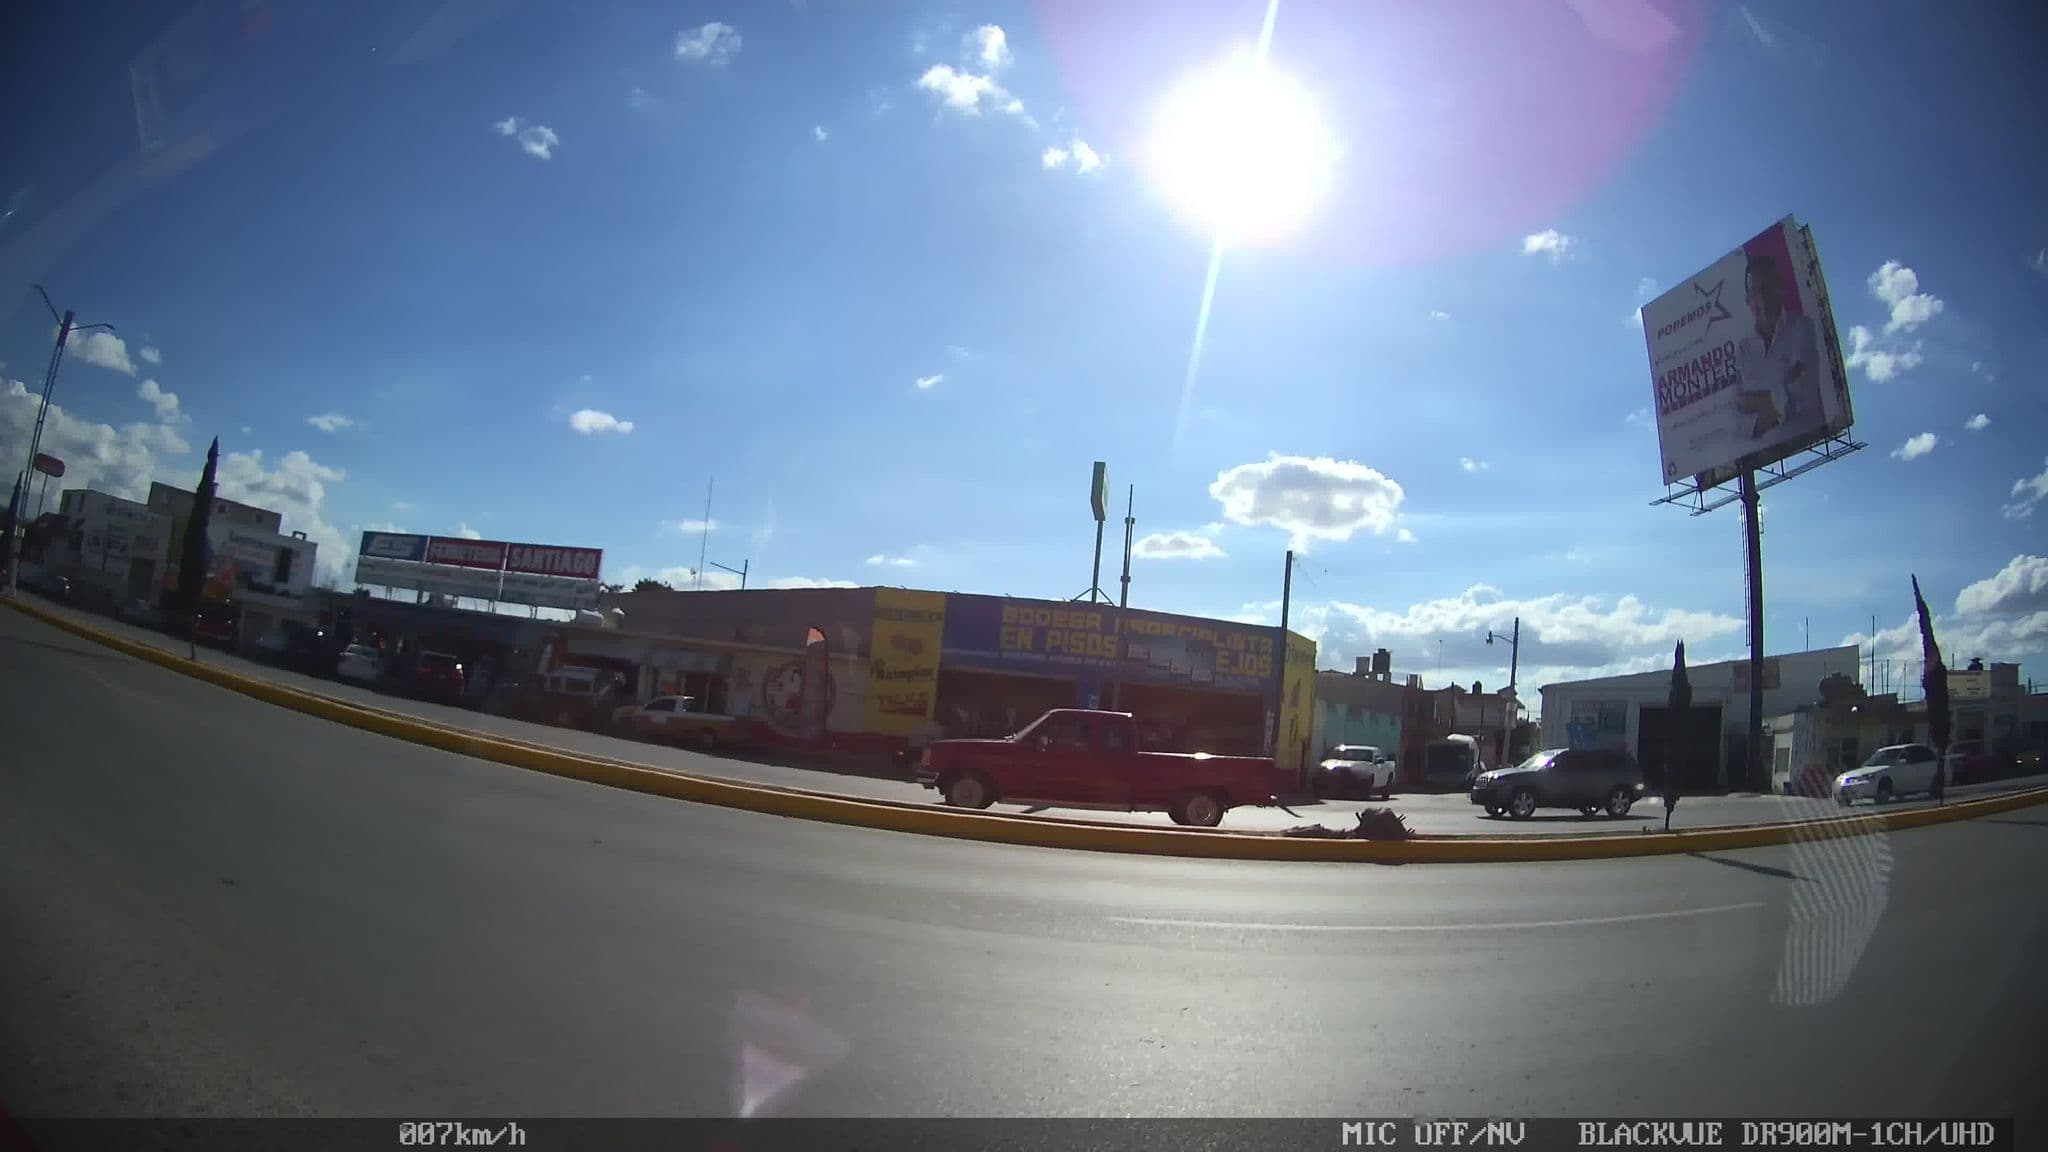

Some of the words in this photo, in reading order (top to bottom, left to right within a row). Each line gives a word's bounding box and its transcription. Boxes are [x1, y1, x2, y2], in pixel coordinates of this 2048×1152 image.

[1657, 301, 1712, 340] PODEMOS
[1657, 341, 1736, 391] ARMANDO
[510, 545, 598, 575] SANTIAGO
[1001, 605, 1102, 630] BODEGA
[1000, 626, 1033, 650] EN
[1045, 629, 1119, 658] PISOS
